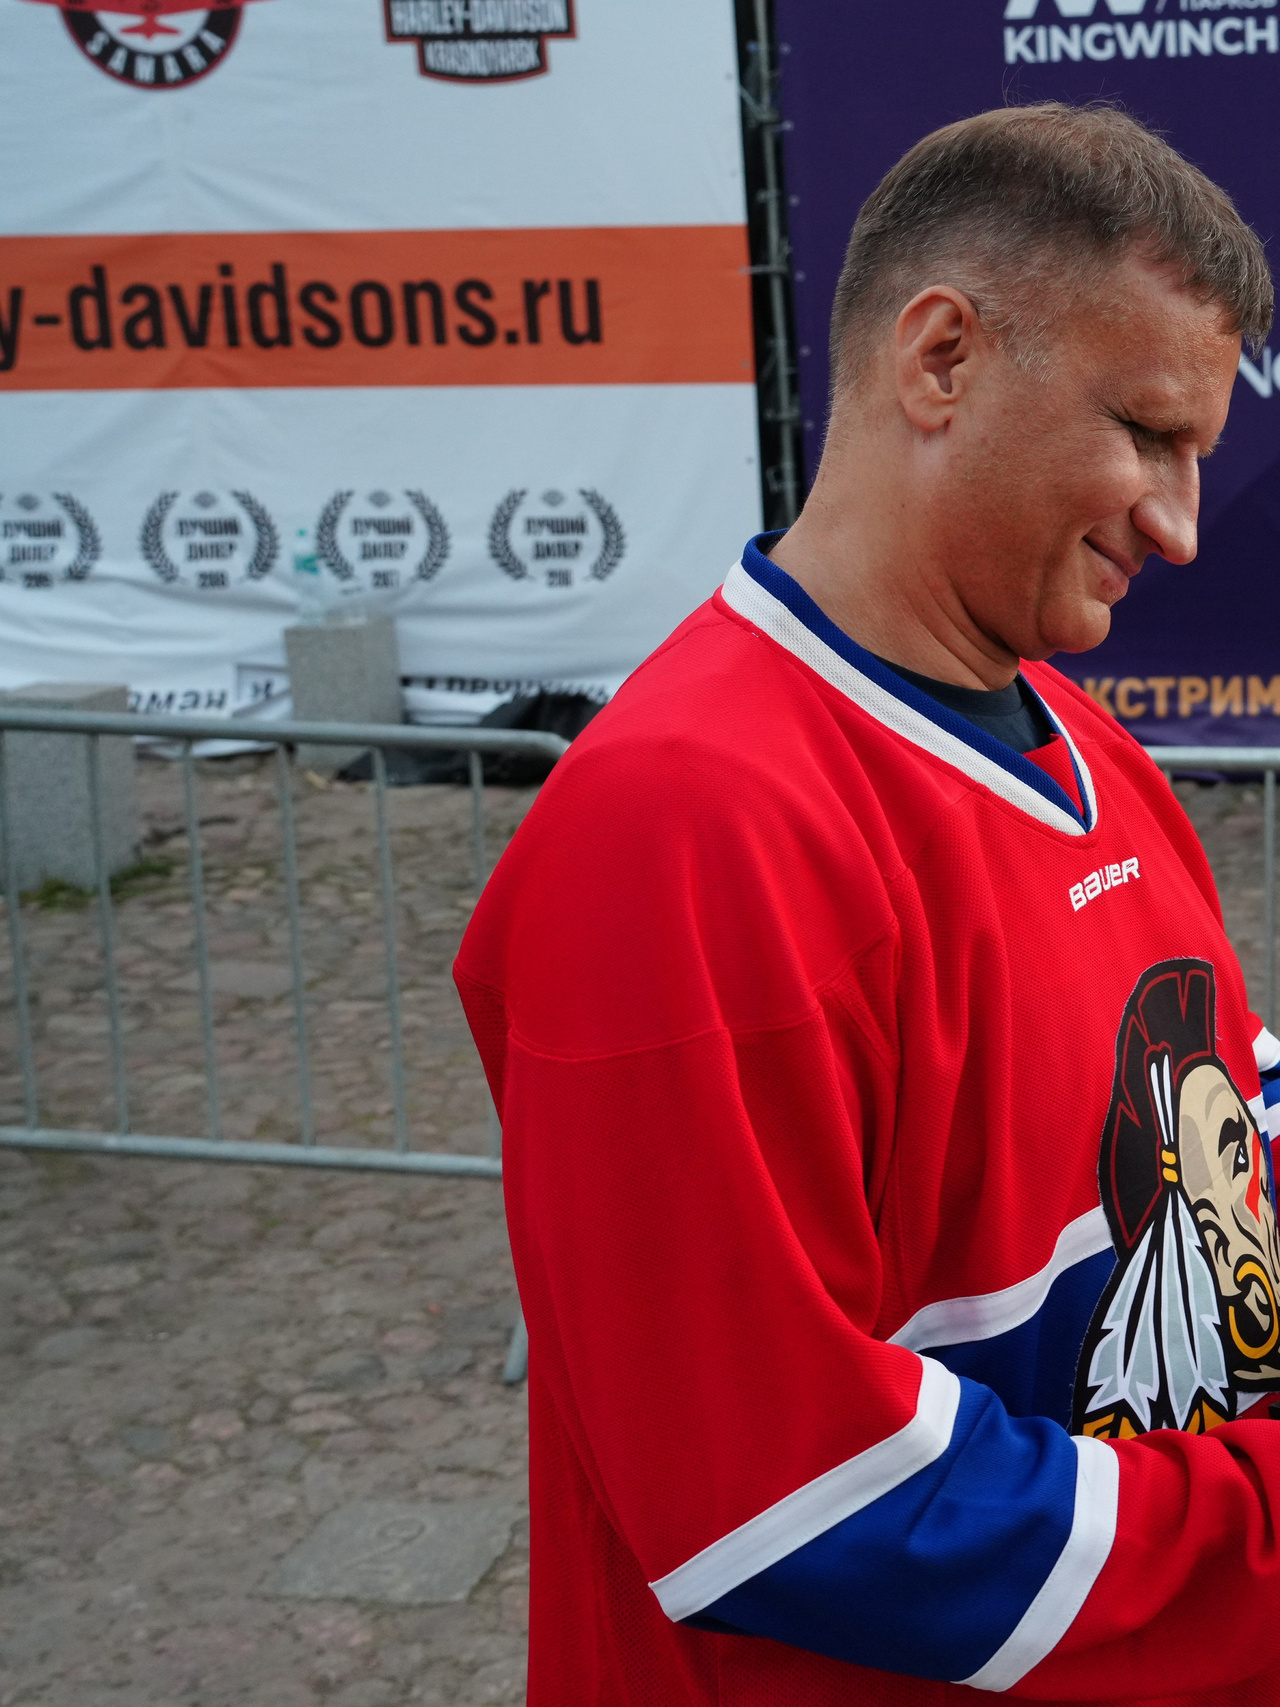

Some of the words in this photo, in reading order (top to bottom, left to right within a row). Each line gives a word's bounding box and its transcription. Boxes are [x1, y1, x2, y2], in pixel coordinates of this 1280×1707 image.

[85, 29, 227, 83] SAMARA
[1003, 15, 1279, 64] KINGWINCH
[1068, 856, 1141, 912] BAUER
